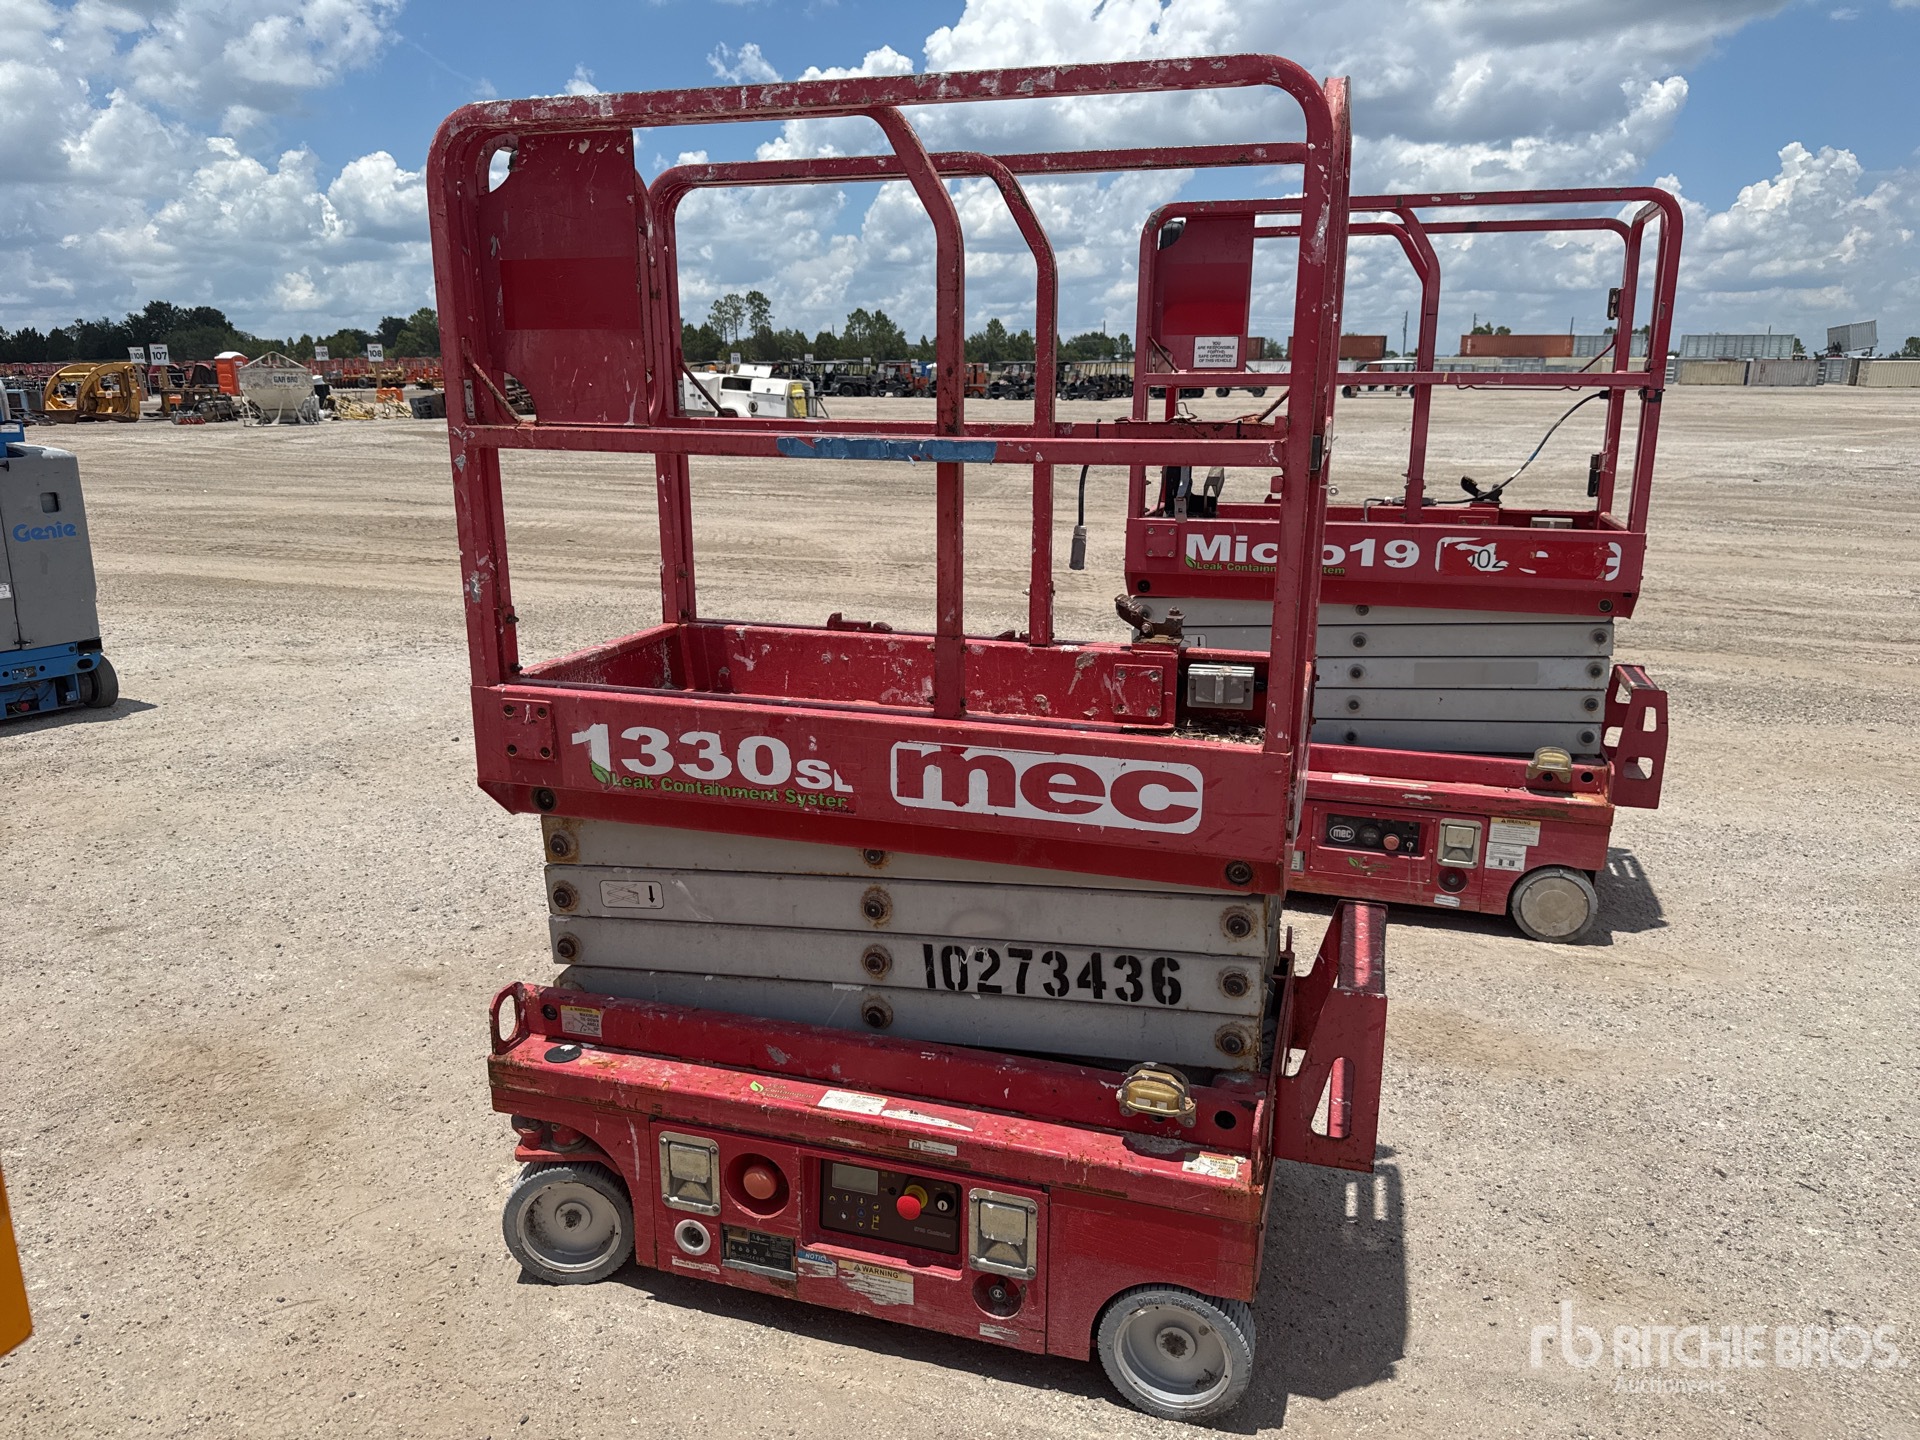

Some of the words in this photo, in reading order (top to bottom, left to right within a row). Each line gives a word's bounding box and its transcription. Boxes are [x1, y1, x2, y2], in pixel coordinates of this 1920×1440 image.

[152, 351, 167, 360] 107
[13, 521, 76, 542] Genie
[1186, 534, 1420, 568] Mico19
[1197, 562, 1222, 570] Leak
[611, 773, 654, 790] Leak
[660, 778, 779, 801] Containment
[891, 742, 1202, 832] mec
[1333, 829, 1351, 838] mec
[922, 943, 1181, 1006] 10273436
[861, 1265, 899, 1279] WARNING
